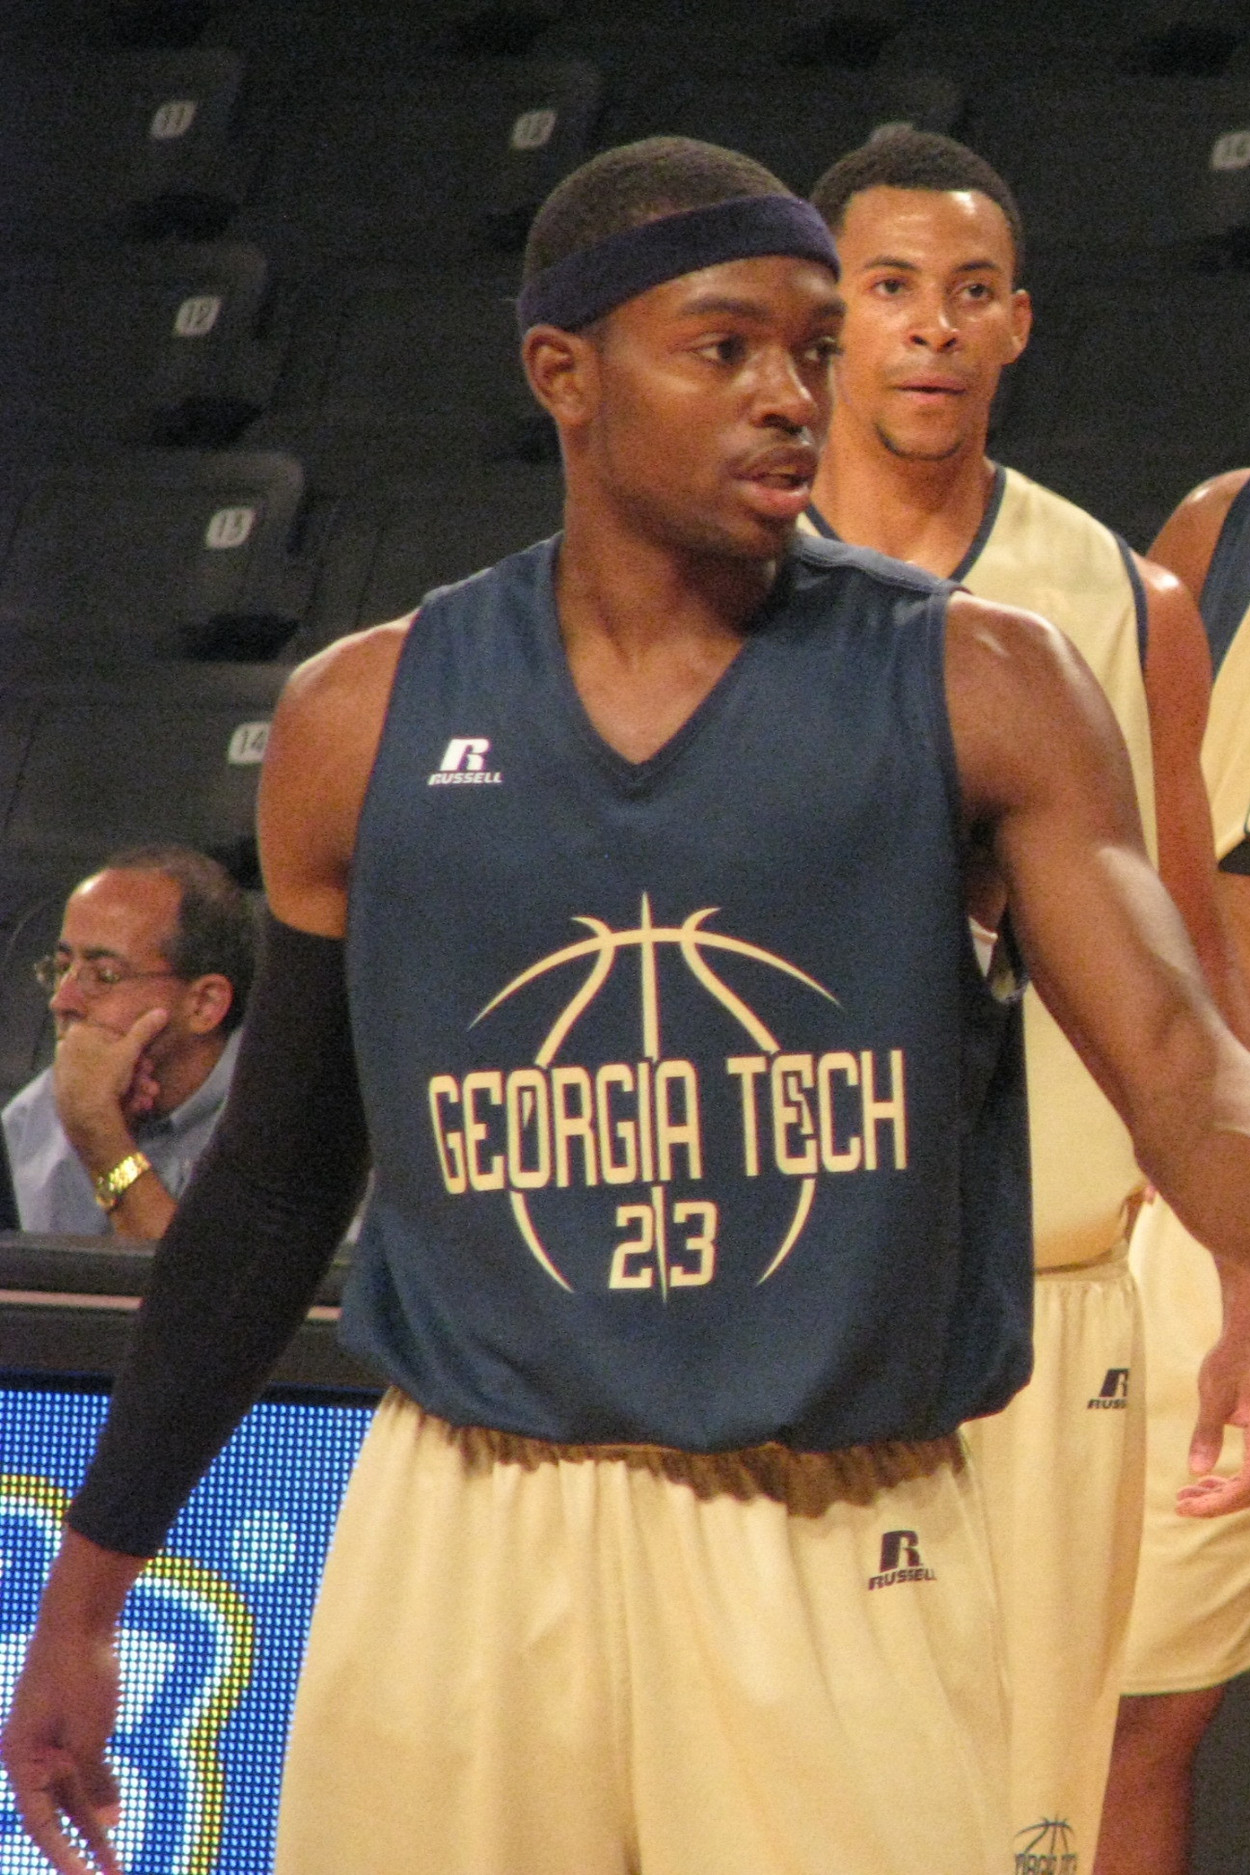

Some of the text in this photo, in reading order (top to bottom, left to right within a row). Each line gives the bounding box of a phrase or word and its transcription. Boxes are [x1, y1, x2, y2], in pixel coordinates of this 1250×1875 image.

[427, 771, 503, 786] RUSSELL
[428, 1049, 907, 1195] GEORGIA TECH
[609, 1200, 717, 1290] 23
[868, 1567, 937, 1591] RUSSELL
